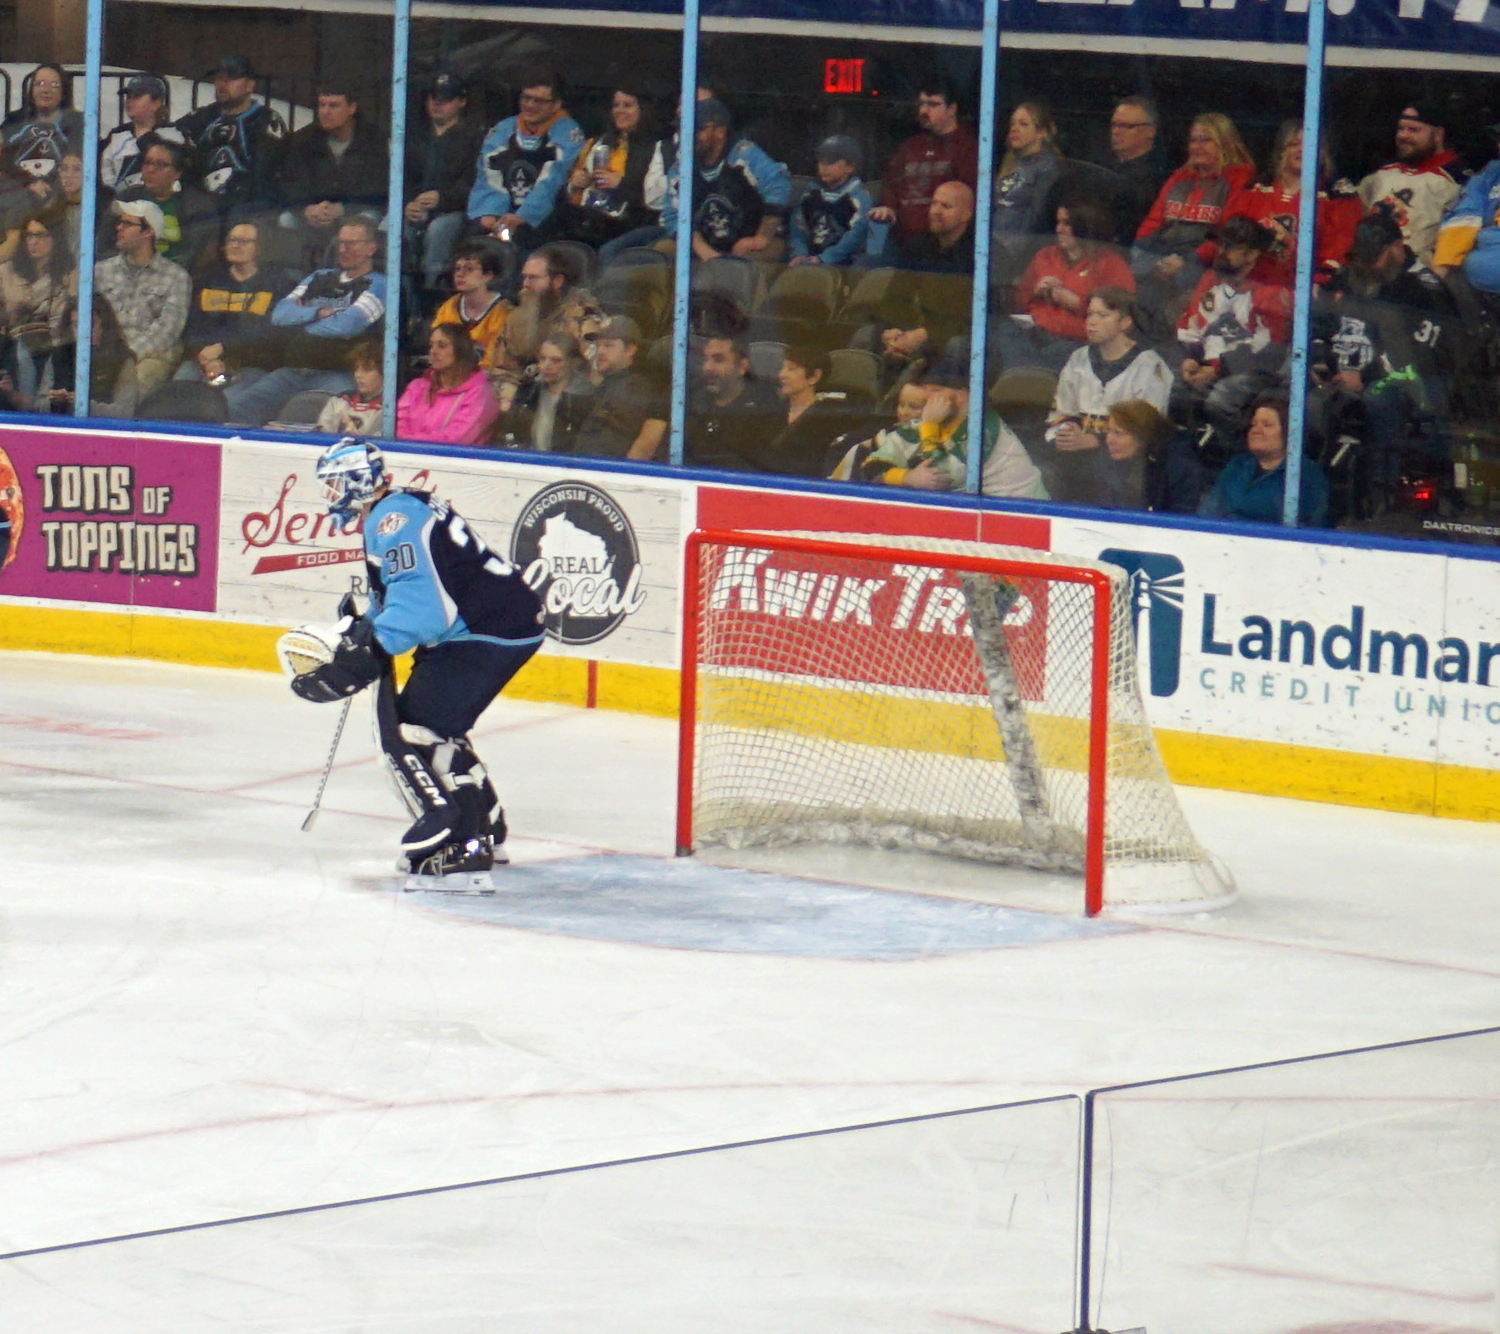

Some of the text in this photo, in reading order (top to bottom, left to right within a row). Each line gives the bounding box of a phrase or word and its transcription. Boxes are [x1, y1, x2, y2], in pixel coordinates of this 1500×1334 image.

[825, 58, 864, 93] EXIT
[37, 464, 170, 516] TONS OF
[524, 489, 625, 533] WISCONSIN PROUD
[41, 520, 197, 575] TOPPINGS
[297, 549, 344, 568] FOOD
[386, 543, 415, 576] 30
[553, 555, 601, 575] REAL
[710, 546, 886, 627] KWIK
[1199, 667, 1361, 707] CREDIT
[402, 752, 448, 808] CCM
